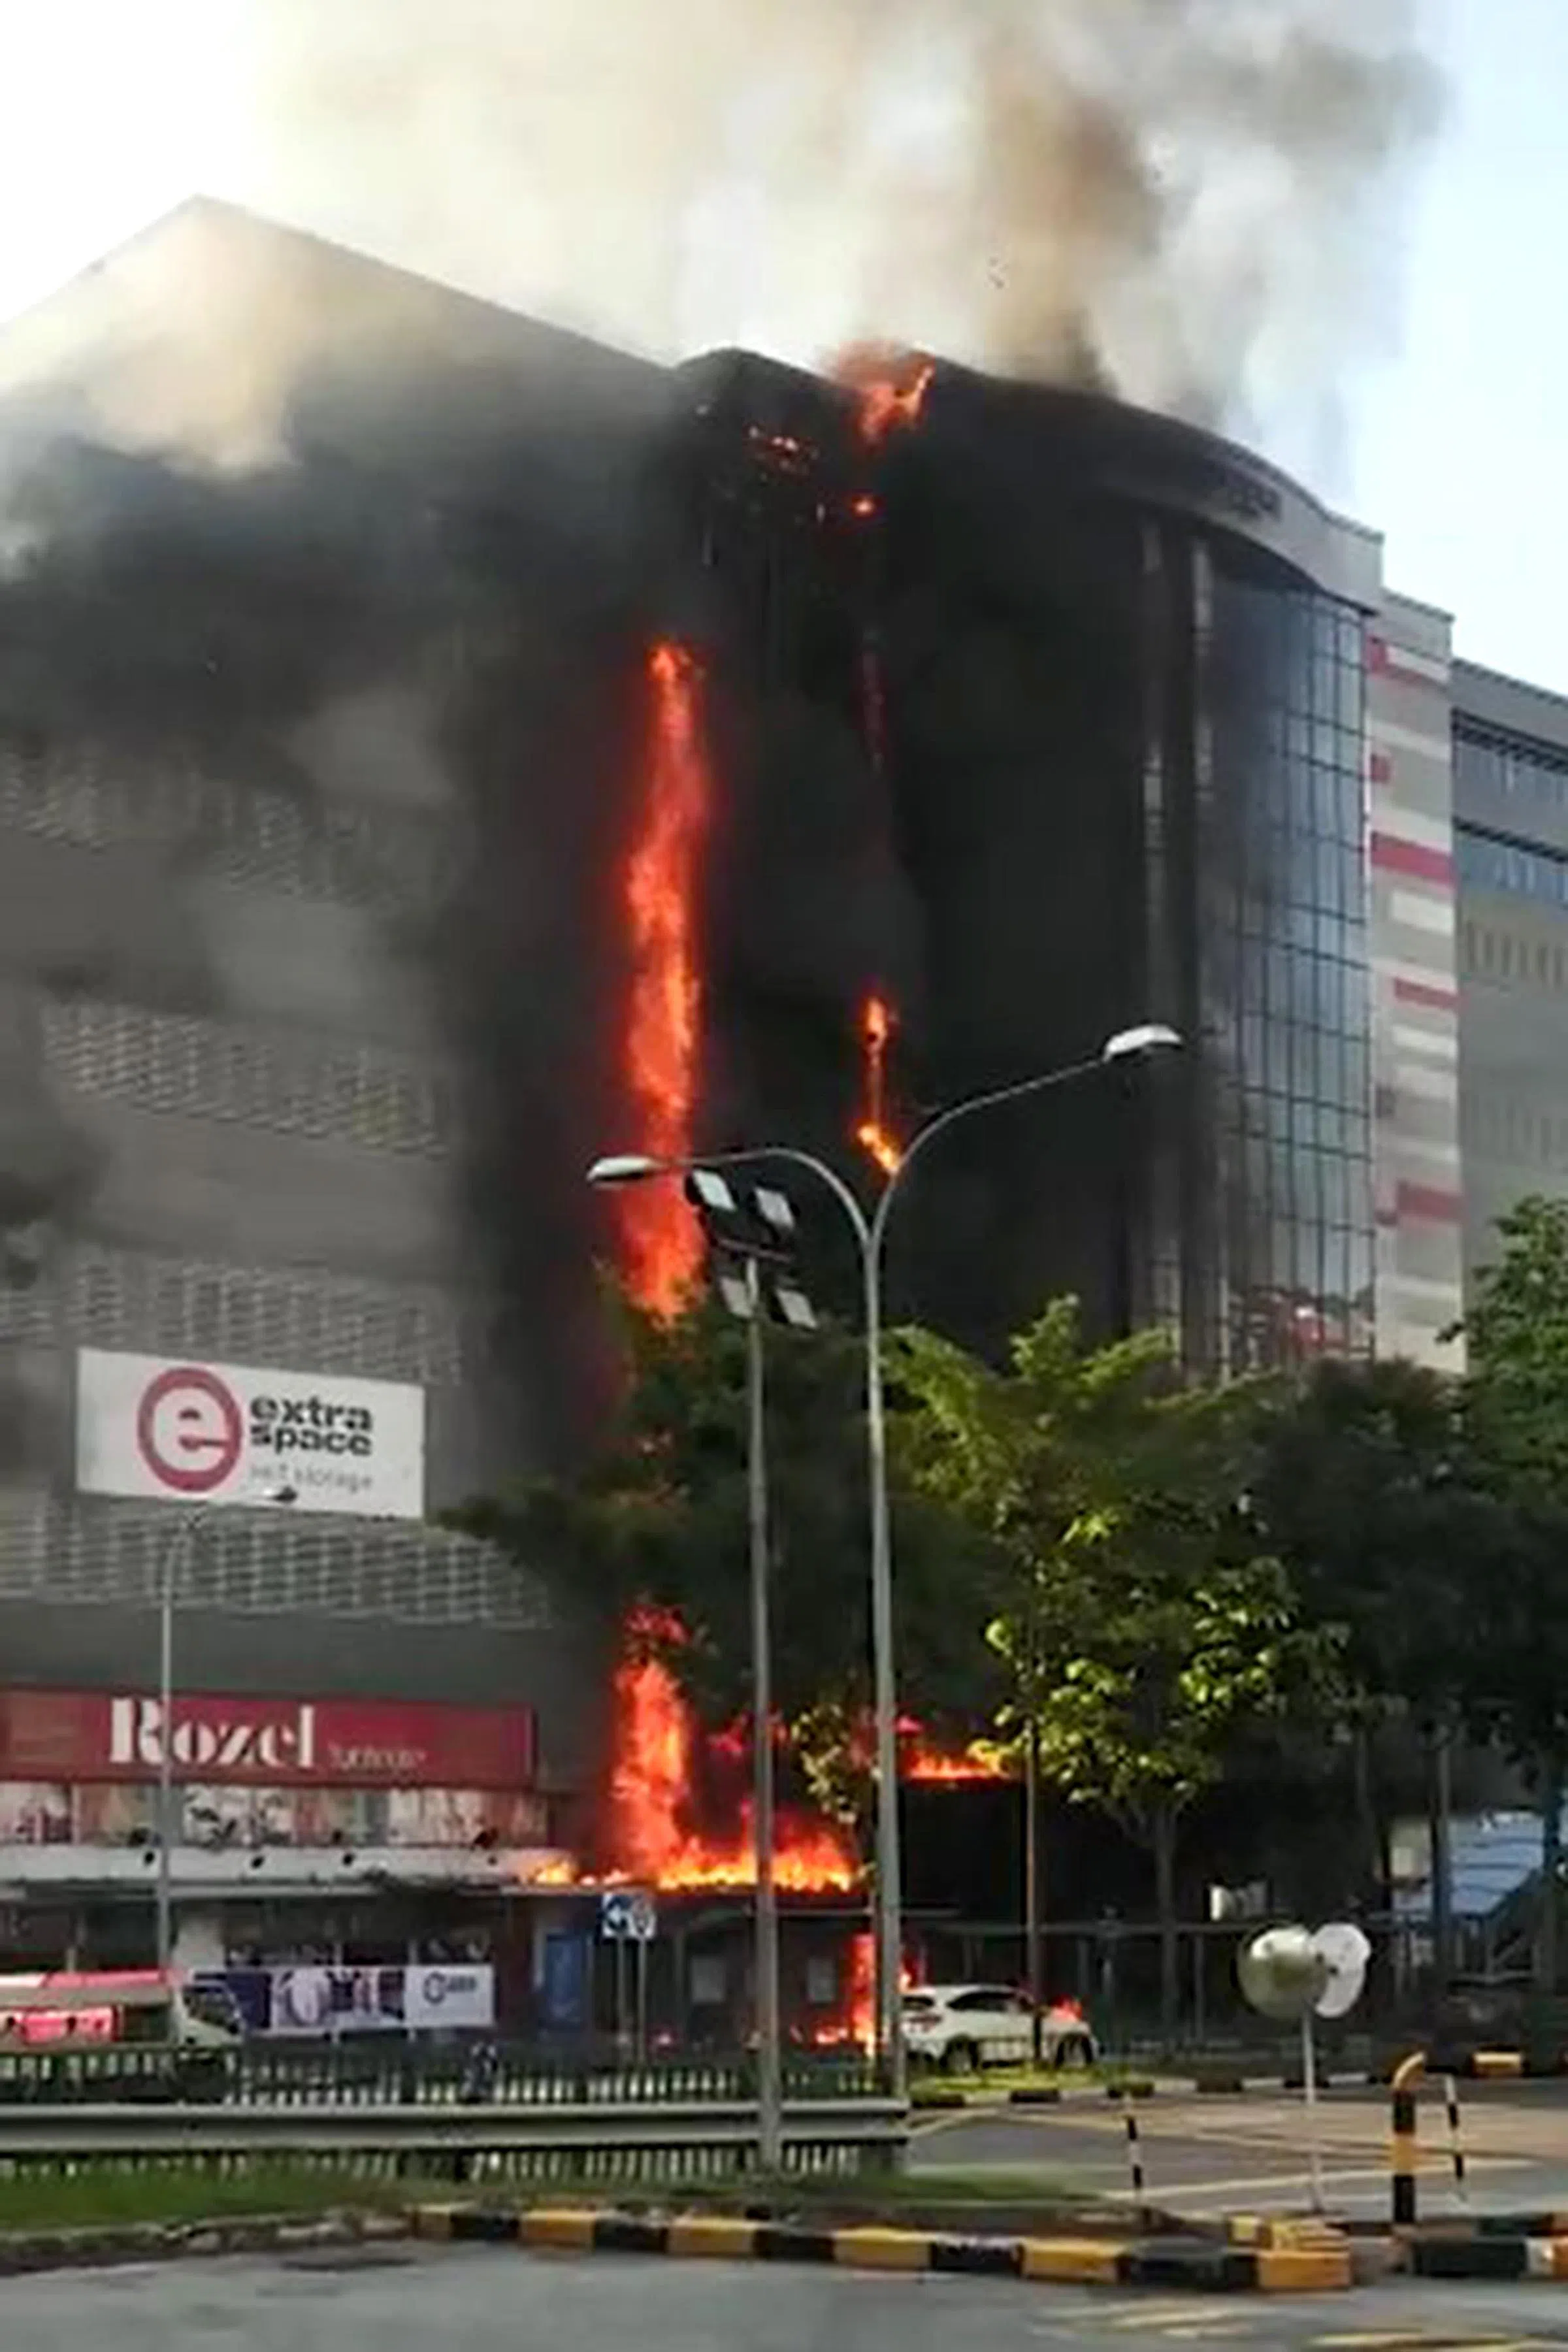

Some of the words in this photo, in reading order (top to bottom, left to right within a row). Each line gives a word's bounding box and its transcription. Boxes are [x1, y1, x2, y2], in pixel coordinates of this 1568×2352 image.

[250, 1396, 372, 1431] extra
[251, 1424, 372, 1456] space
[110, 1698, 314, 1769] Rozel
